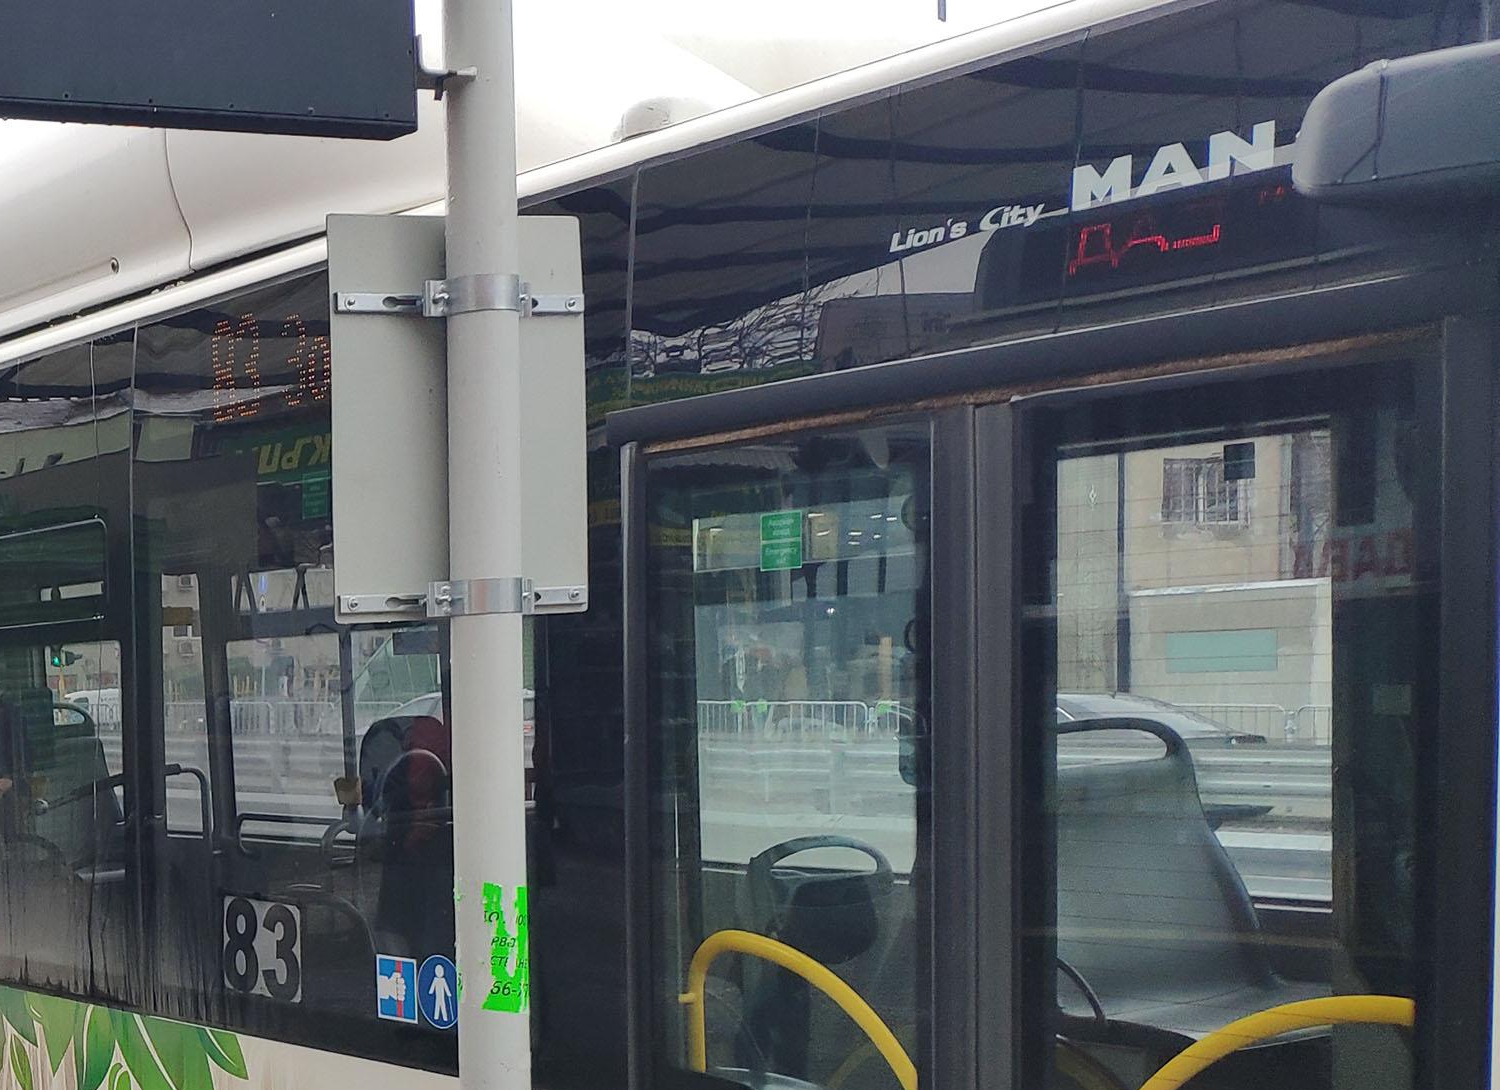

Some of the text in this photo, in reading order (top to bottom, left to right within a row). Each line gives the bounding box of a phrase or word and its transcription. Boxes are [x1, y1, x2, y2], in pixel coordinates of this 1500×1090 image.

[1071, 119, 1276, 213] MAN
[889, 202, 1046, 253] Lion's City
[212, 313, 260, 421] 83
[224, 896, 300, 1001] 83
